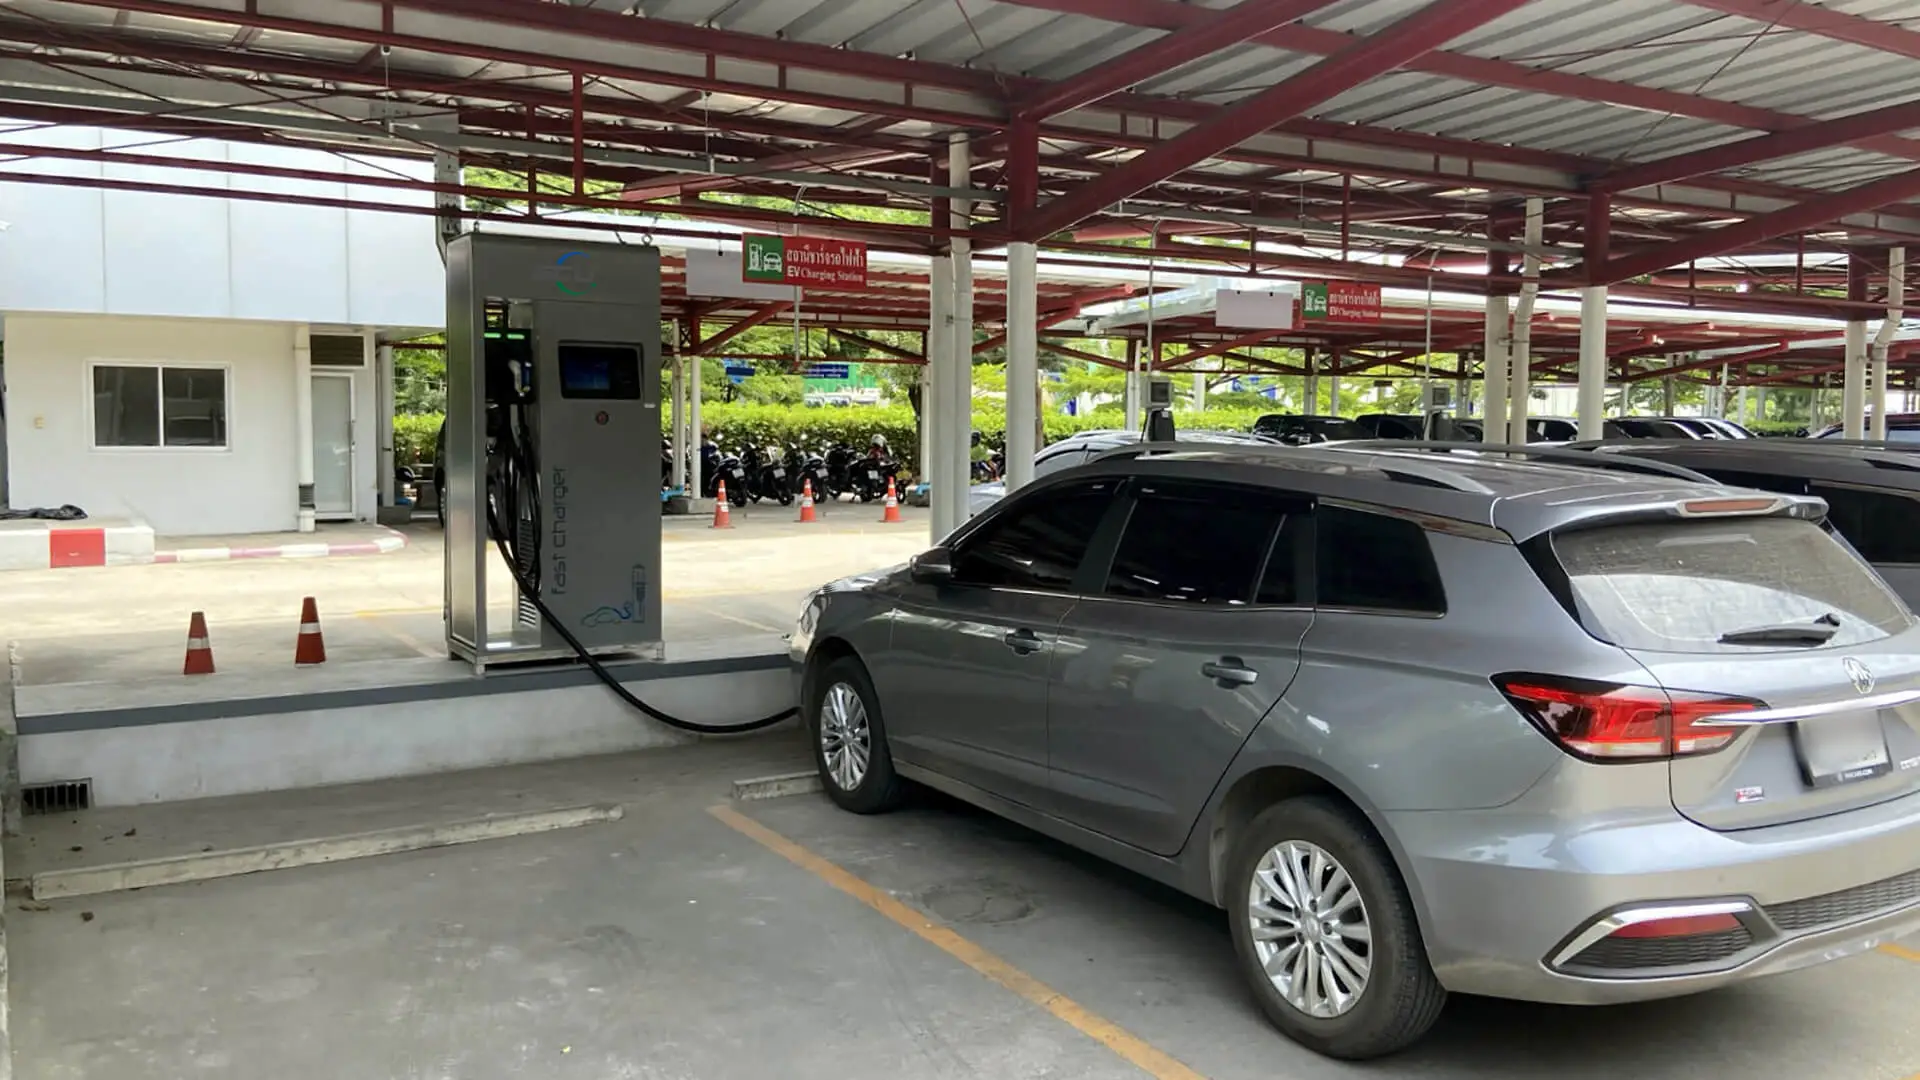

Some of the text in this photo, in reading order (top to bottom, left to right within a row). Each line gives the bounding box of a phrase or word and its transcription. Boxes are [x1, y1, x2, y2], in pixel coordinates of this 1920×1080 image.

[787, 265, 863, 283] EV Charging Station
[551, 465, 569, 596] fast charger
